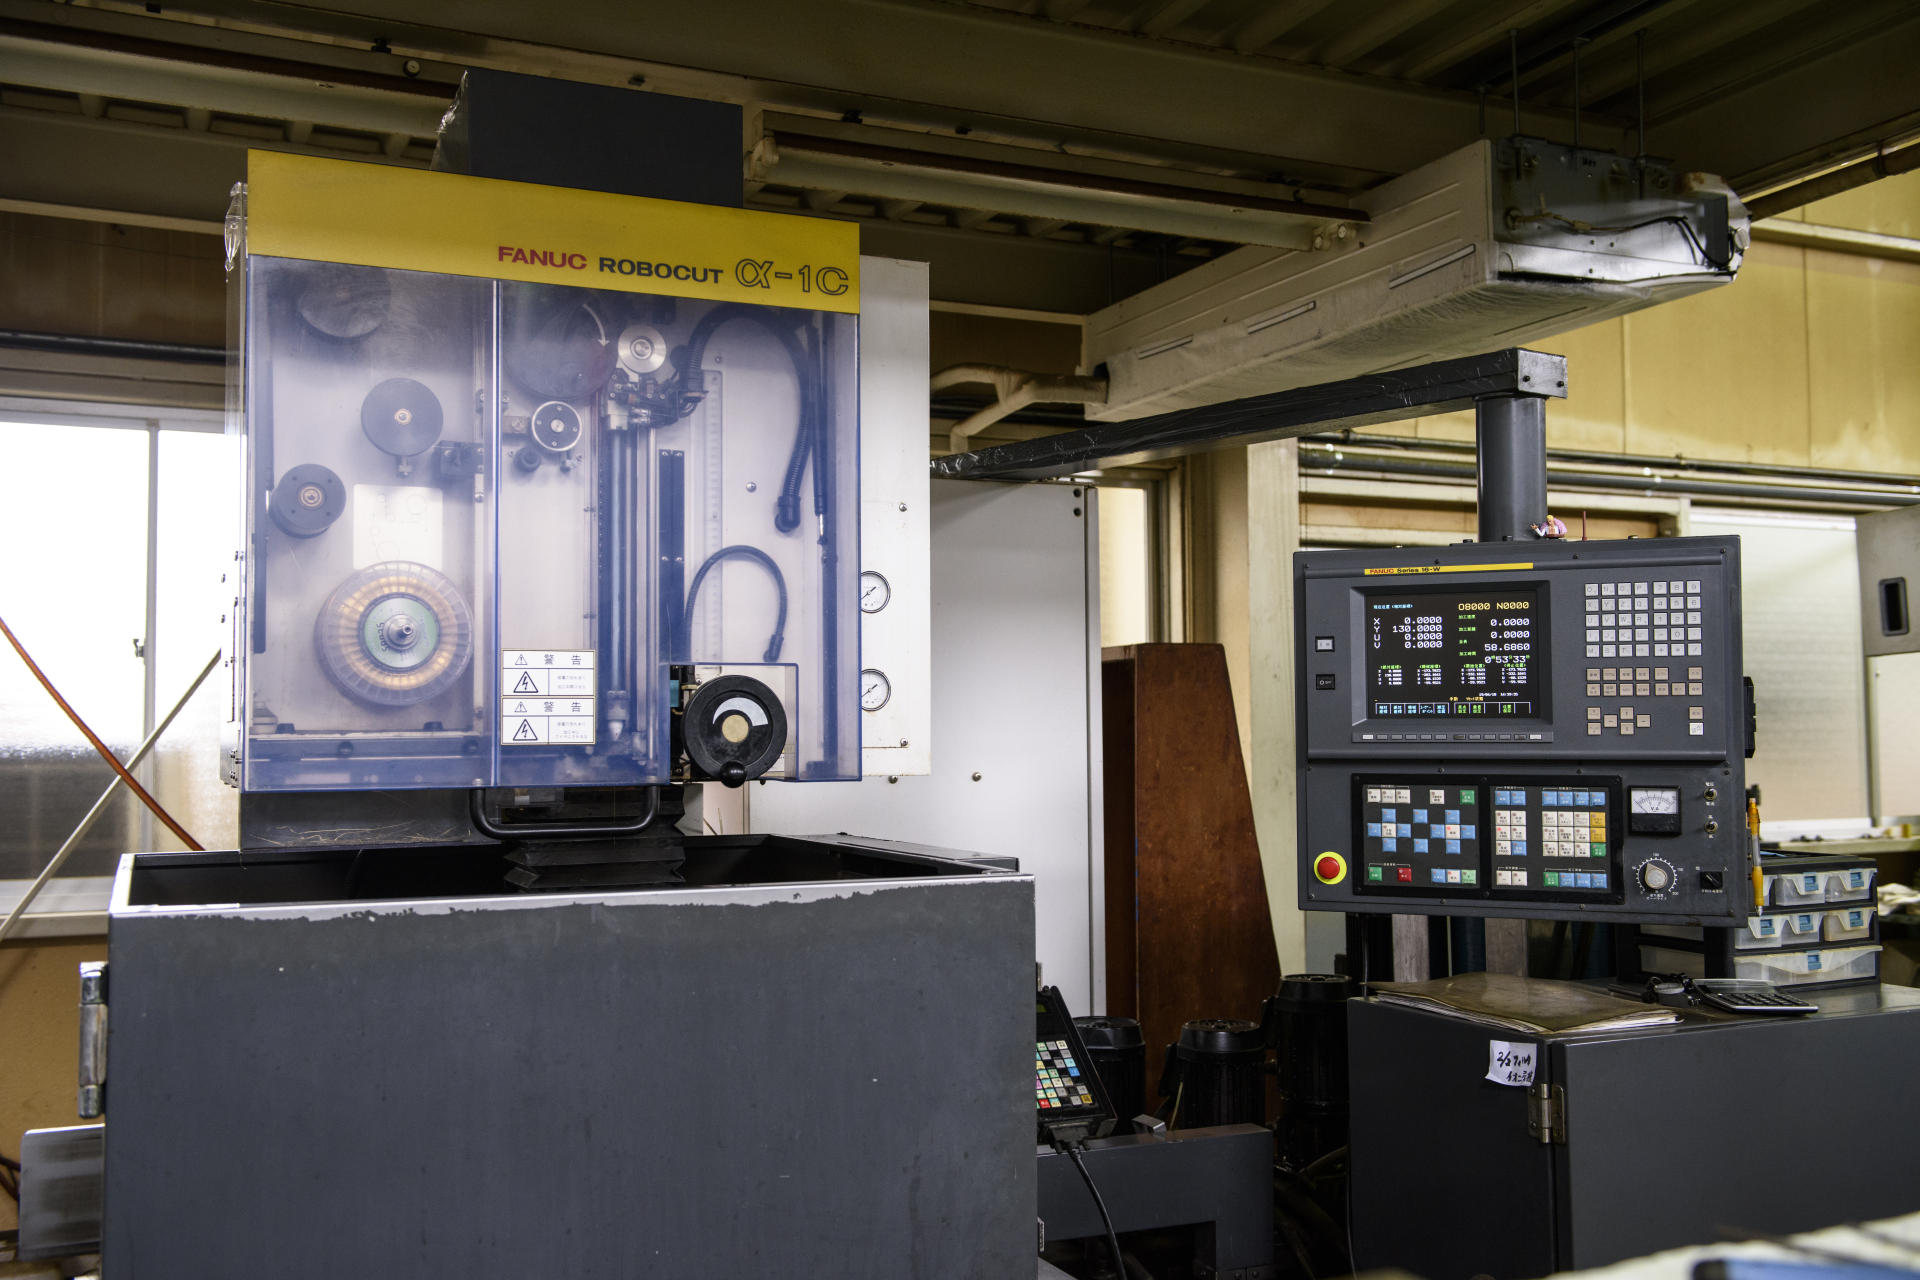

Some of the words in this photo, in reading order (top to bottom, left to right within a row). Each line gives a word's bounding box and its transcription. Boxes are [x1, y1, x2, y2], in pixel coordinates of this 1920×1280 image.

[498, 246, 588, 270] FANUC
[599, 256, 724, 284] ROBOCUT
[1496, 601, 1529, 610] N0000
[1404, 616, 1442, 624] 0.0000
[1490, 618, 1530, 626] 0.0000
[1392, 625, 1442, 633] 130.0000
[1490, 631, 1530, 639] 0.0000
[1404, 641, 1442, 649] 0.0000
